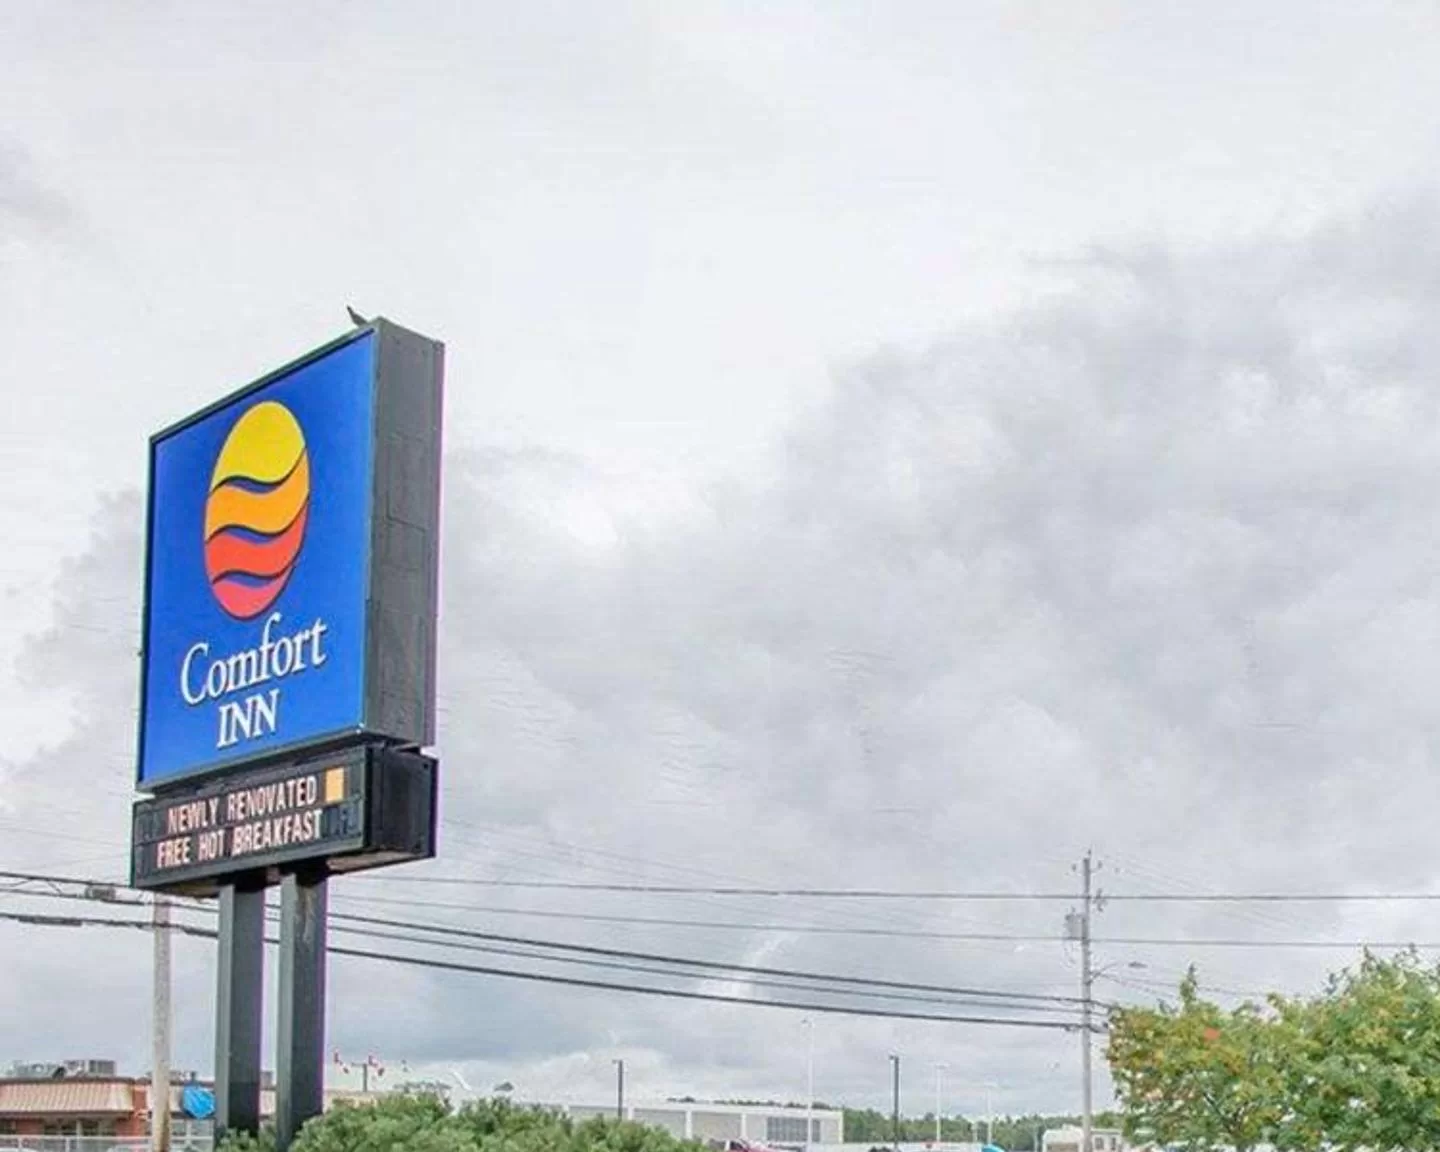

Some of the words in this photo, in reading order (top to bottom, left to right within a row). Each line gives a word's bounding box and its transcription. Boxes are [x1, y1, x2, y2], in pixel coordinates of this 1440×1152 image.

[180, 611, 328, 705] Comfort
[216, 688, 280, 748] INN
[168, 797, 220, 834] NEWLY
[227, 775, 318, 822] RENOVATED
[157, 836, 191, 868] FREE
[198, 830, 225, 861] HOT
[230, 809, 324, 857] BREAKFAST
